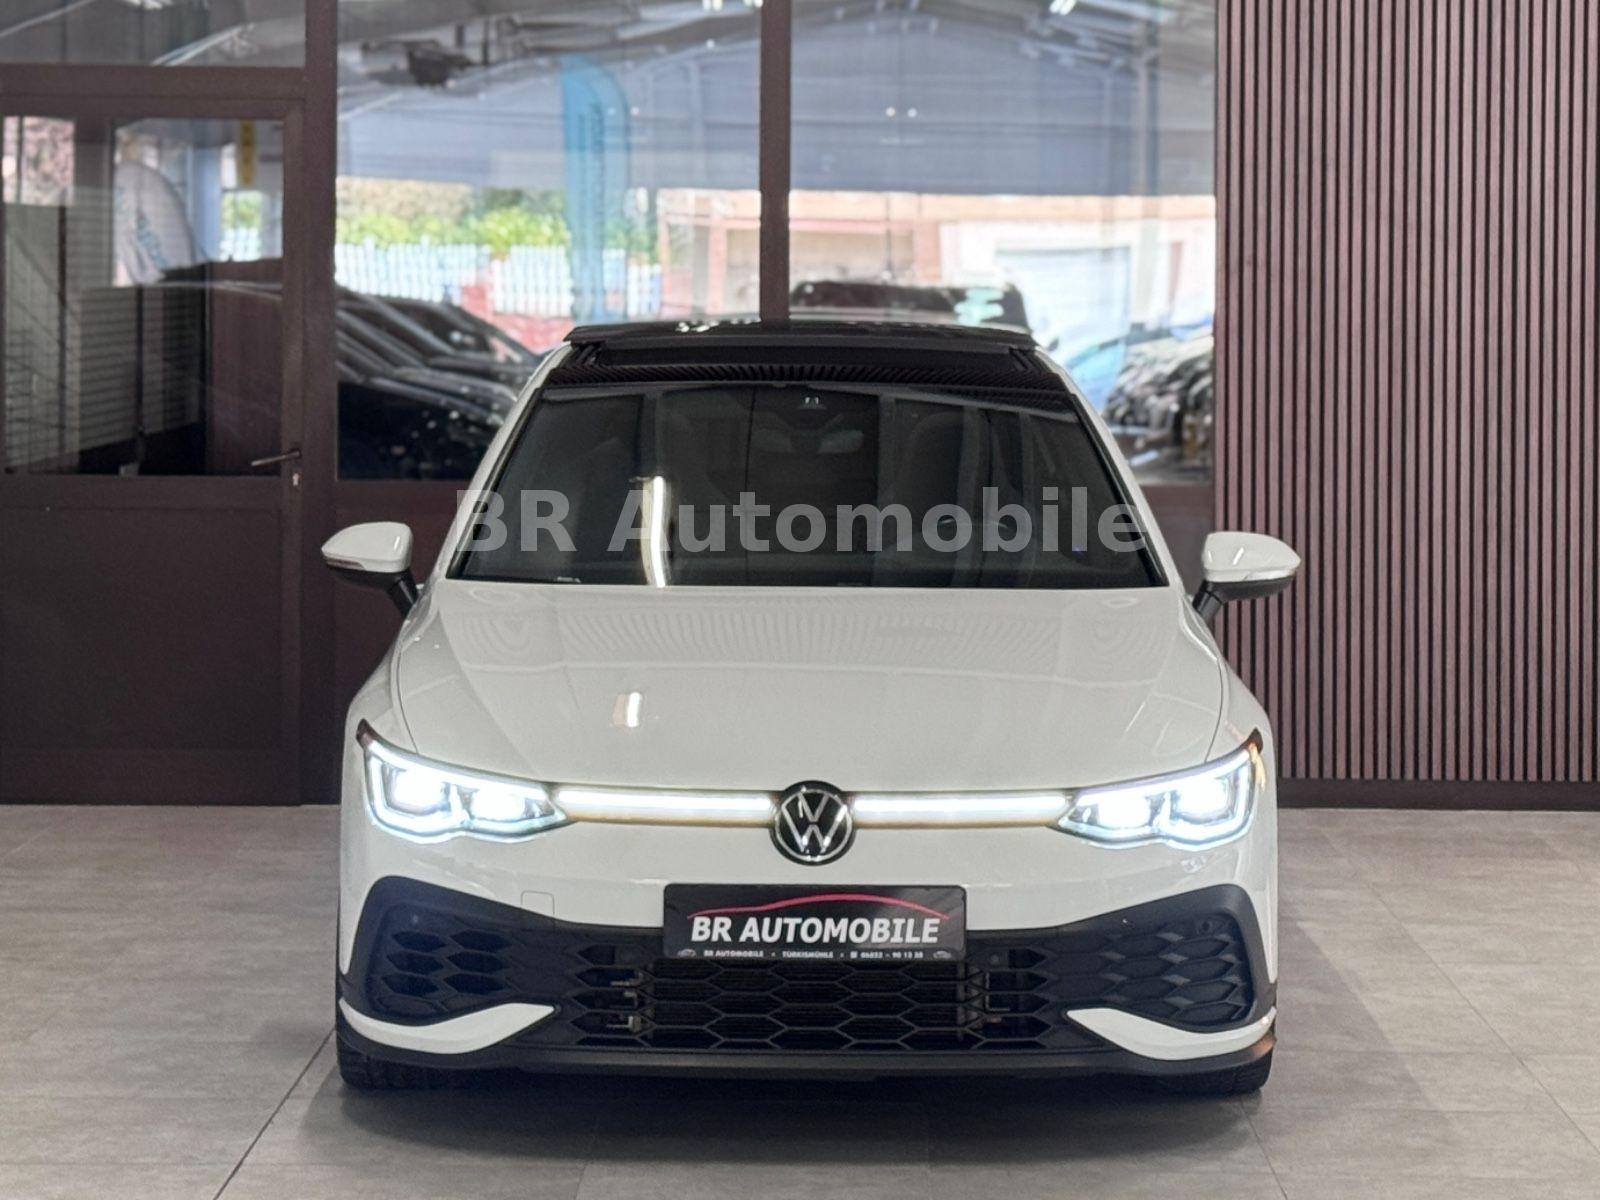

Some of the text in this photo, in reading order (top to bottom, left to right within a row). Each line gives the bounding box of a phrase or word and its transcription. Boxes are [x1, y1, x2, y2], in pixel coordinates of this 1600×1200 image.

[779, 789, 849, 856] VW
[691, 916, 941, 944] BR AUTOMOBILE
